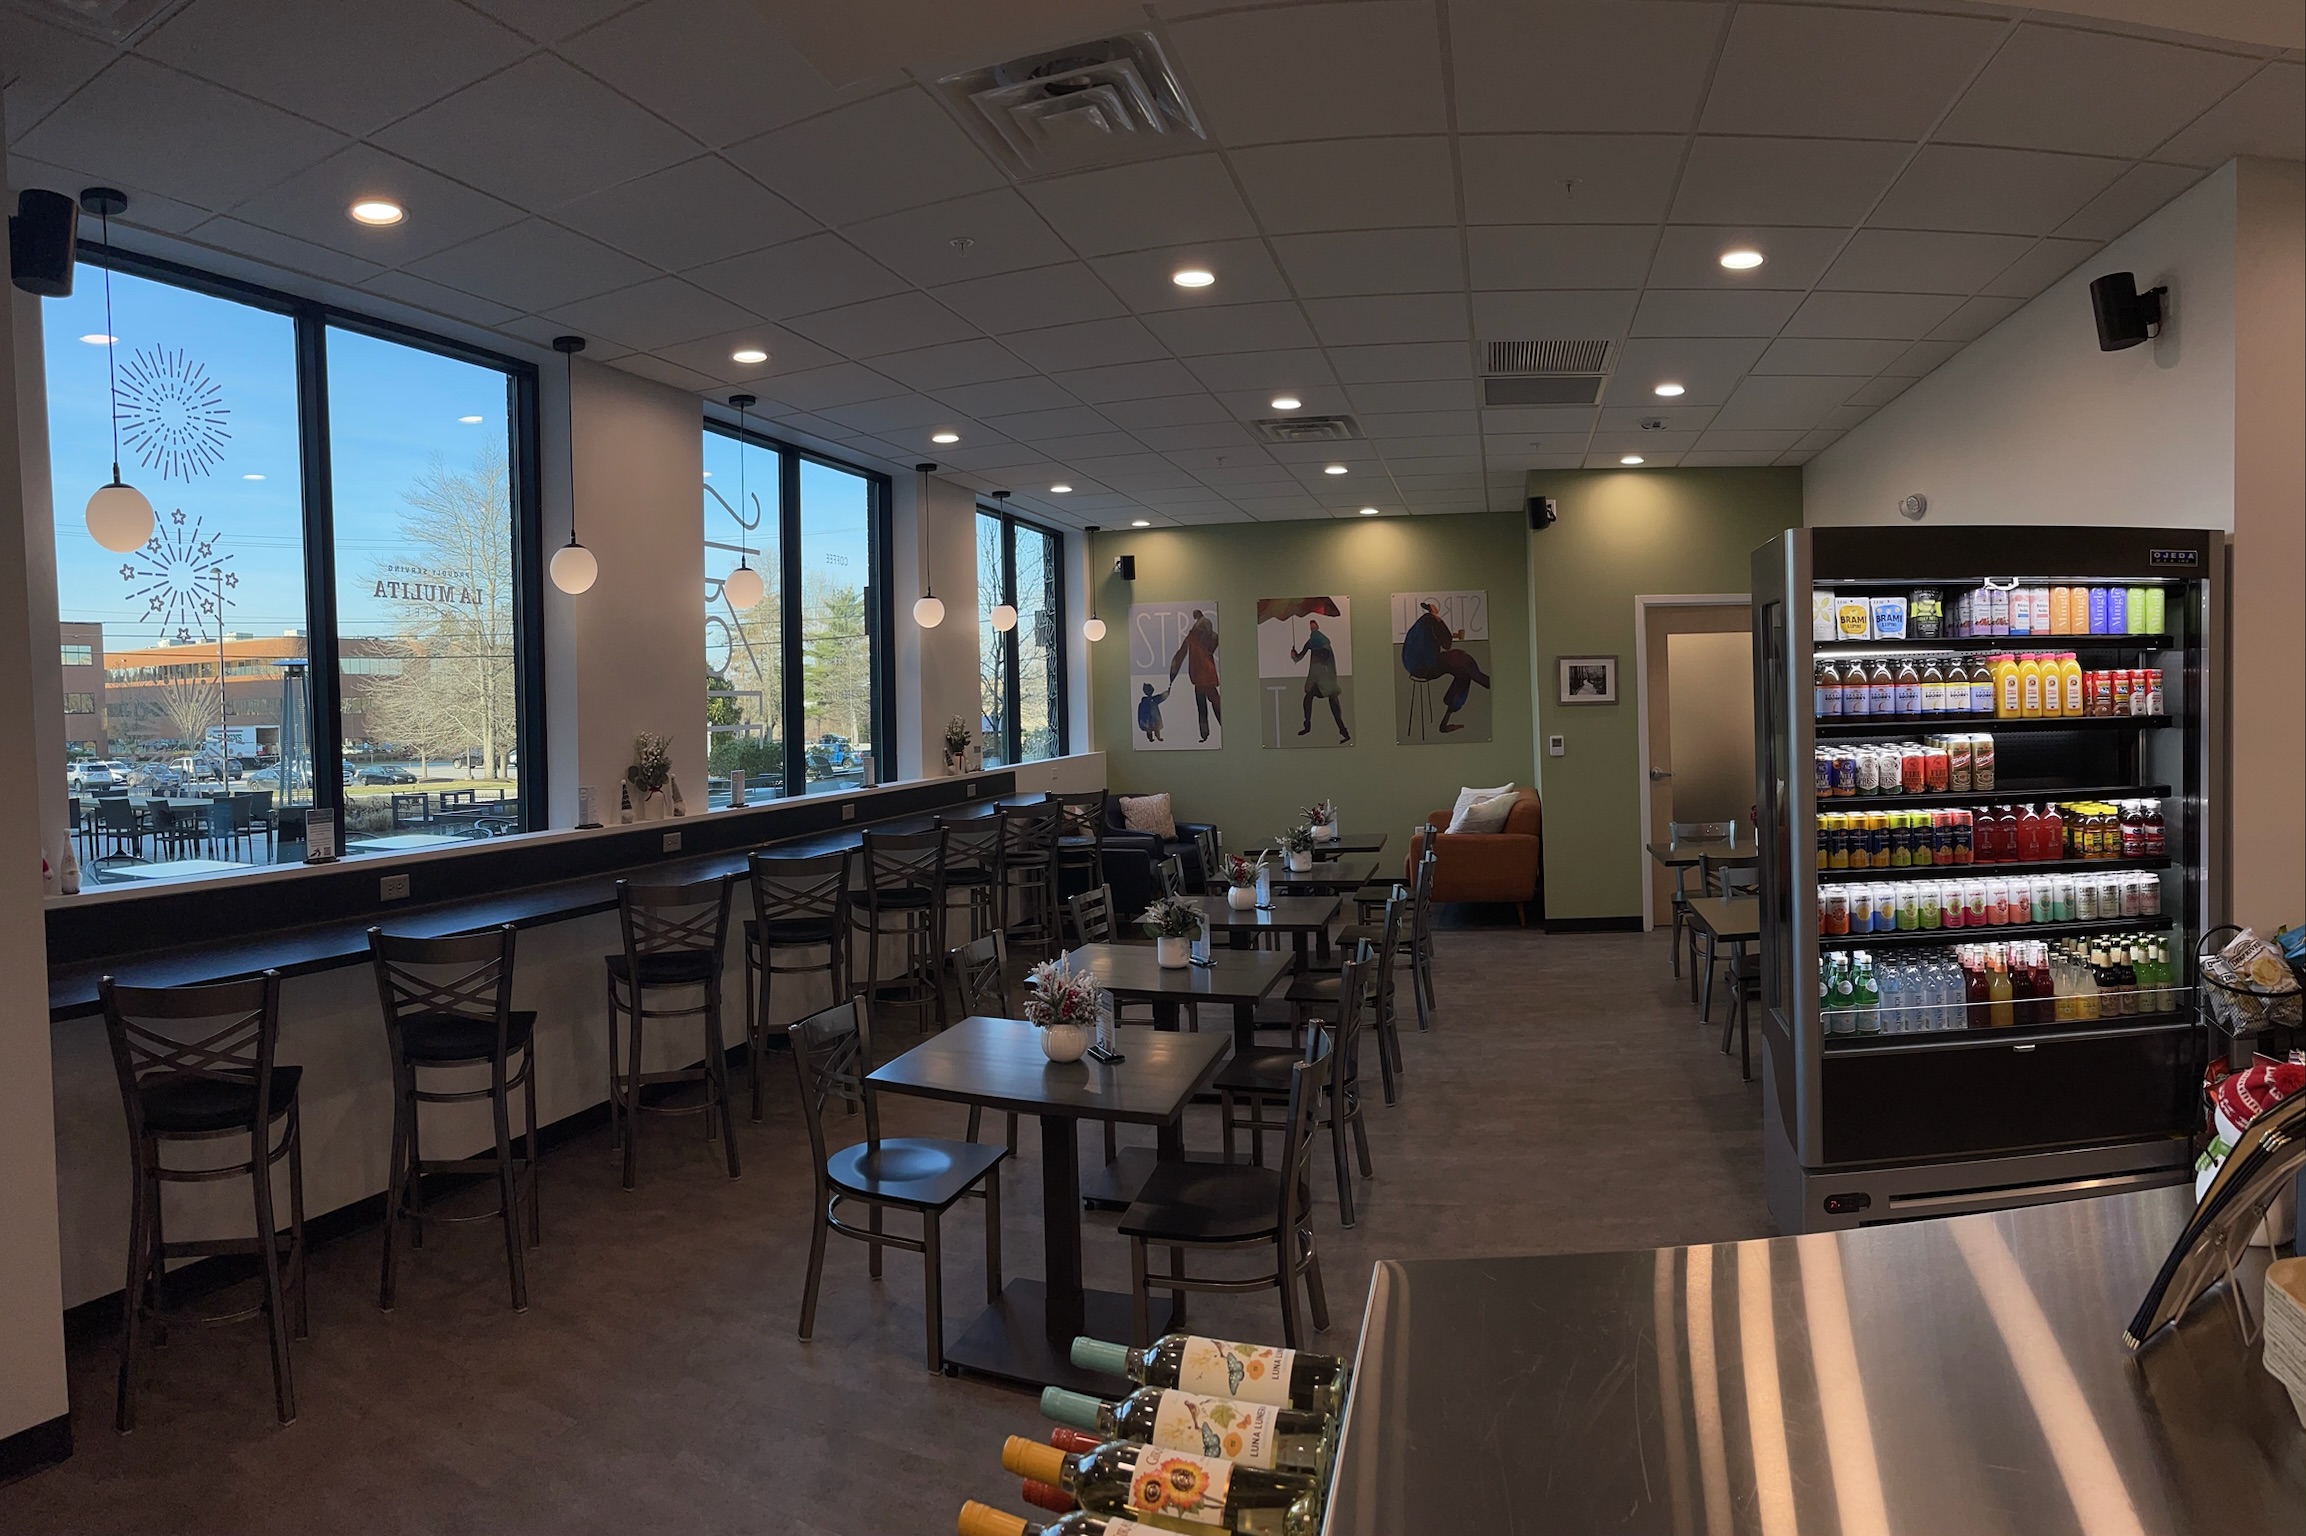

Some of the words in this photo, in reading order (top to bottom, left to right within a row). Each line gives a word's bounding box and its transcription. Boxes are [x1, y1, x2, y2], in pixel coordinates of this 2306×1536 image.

[1840, 615, 1867, 624] BRAMI
[1876, 614, 1903, 623] BRAMI
[1271, 1359, 1282, 1380] LUNA
[1250, 1431, 1261, 1457] LUNA
